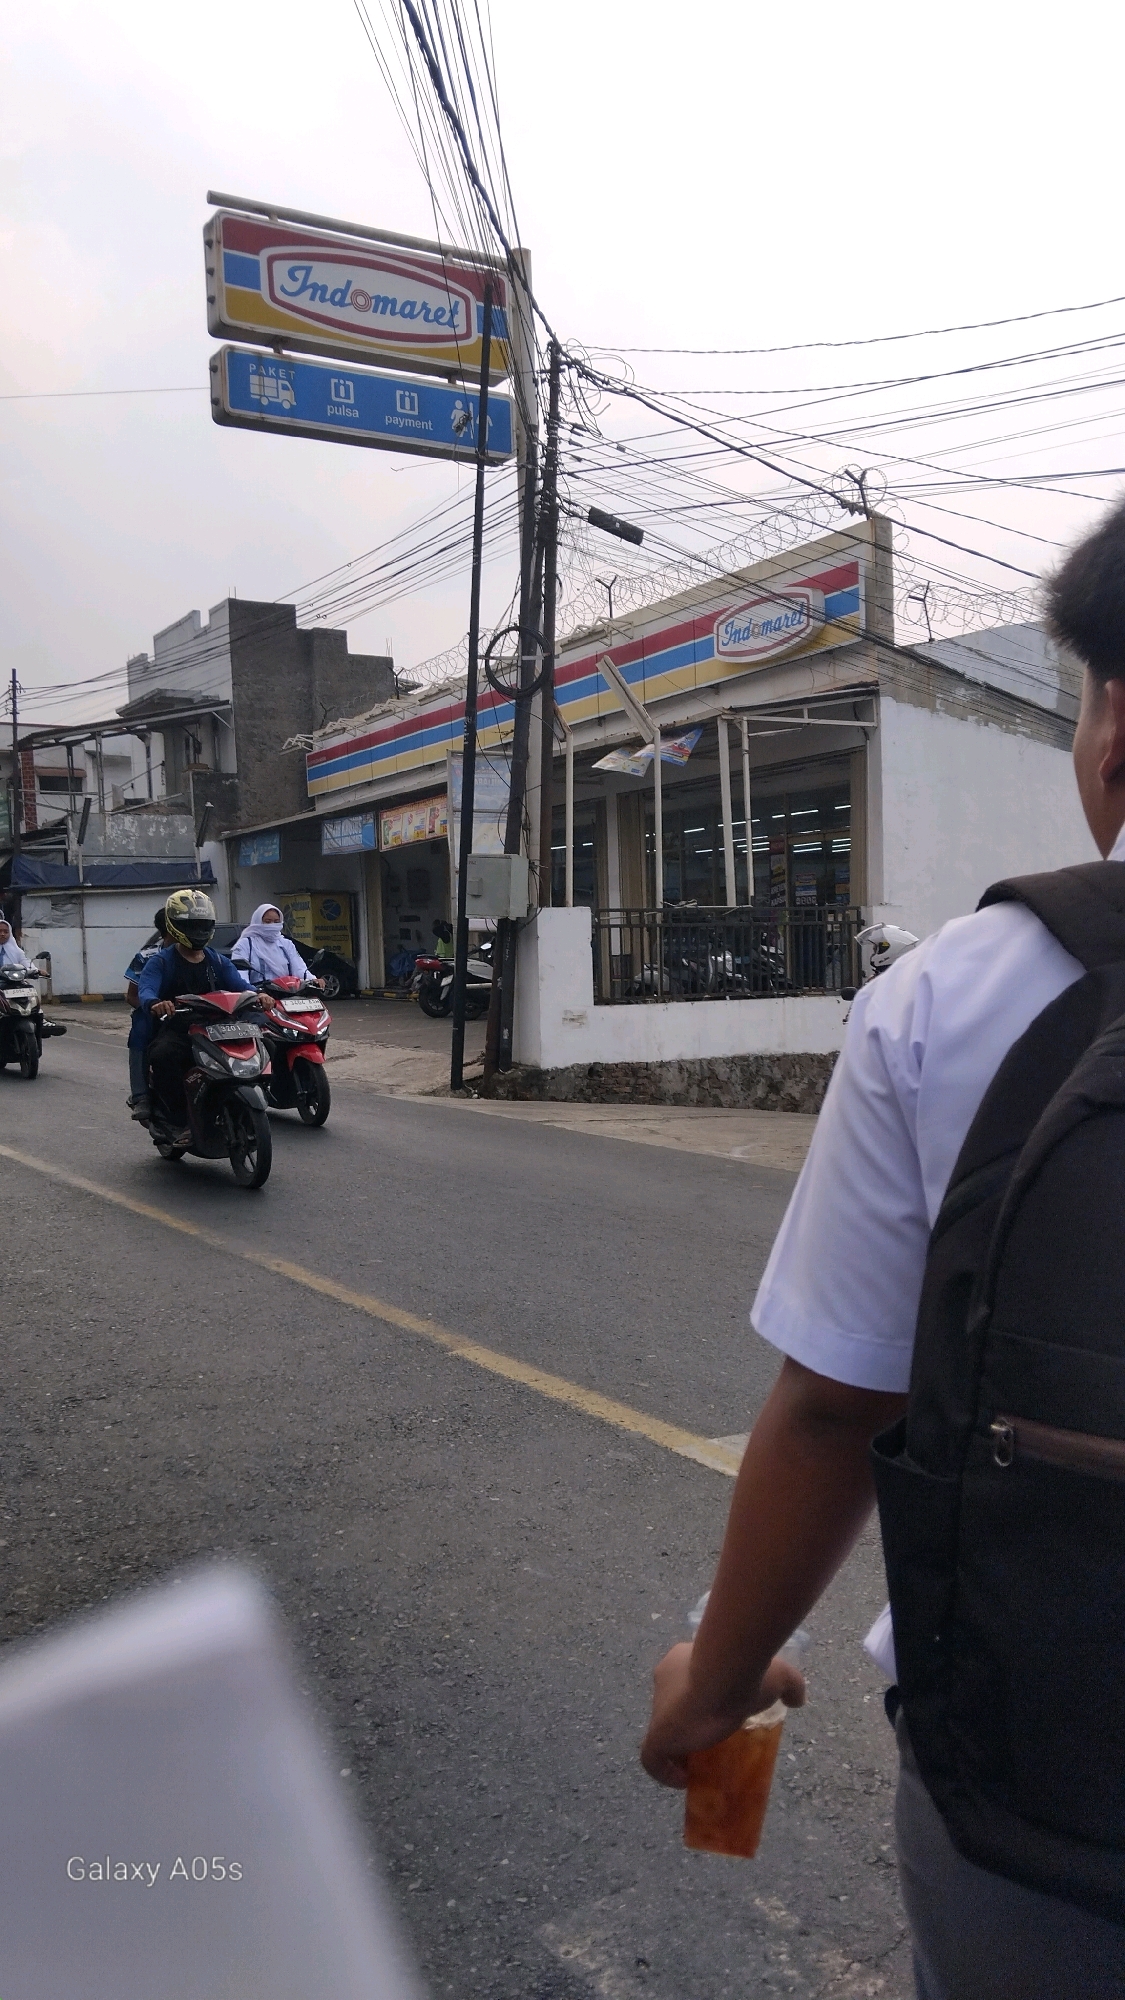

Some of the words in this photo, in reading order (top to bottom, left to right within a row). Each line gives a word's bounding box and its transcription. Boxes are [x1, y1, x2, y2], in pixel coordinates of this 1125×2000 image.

[279, 265, 460, 329] Indomaret
[249, 363, 296, 380] PAKET
[327, 404, 360, 419] pulsa
[385, 415, 434, 432] payment
[721, 601, 805, 647] Indomaret
